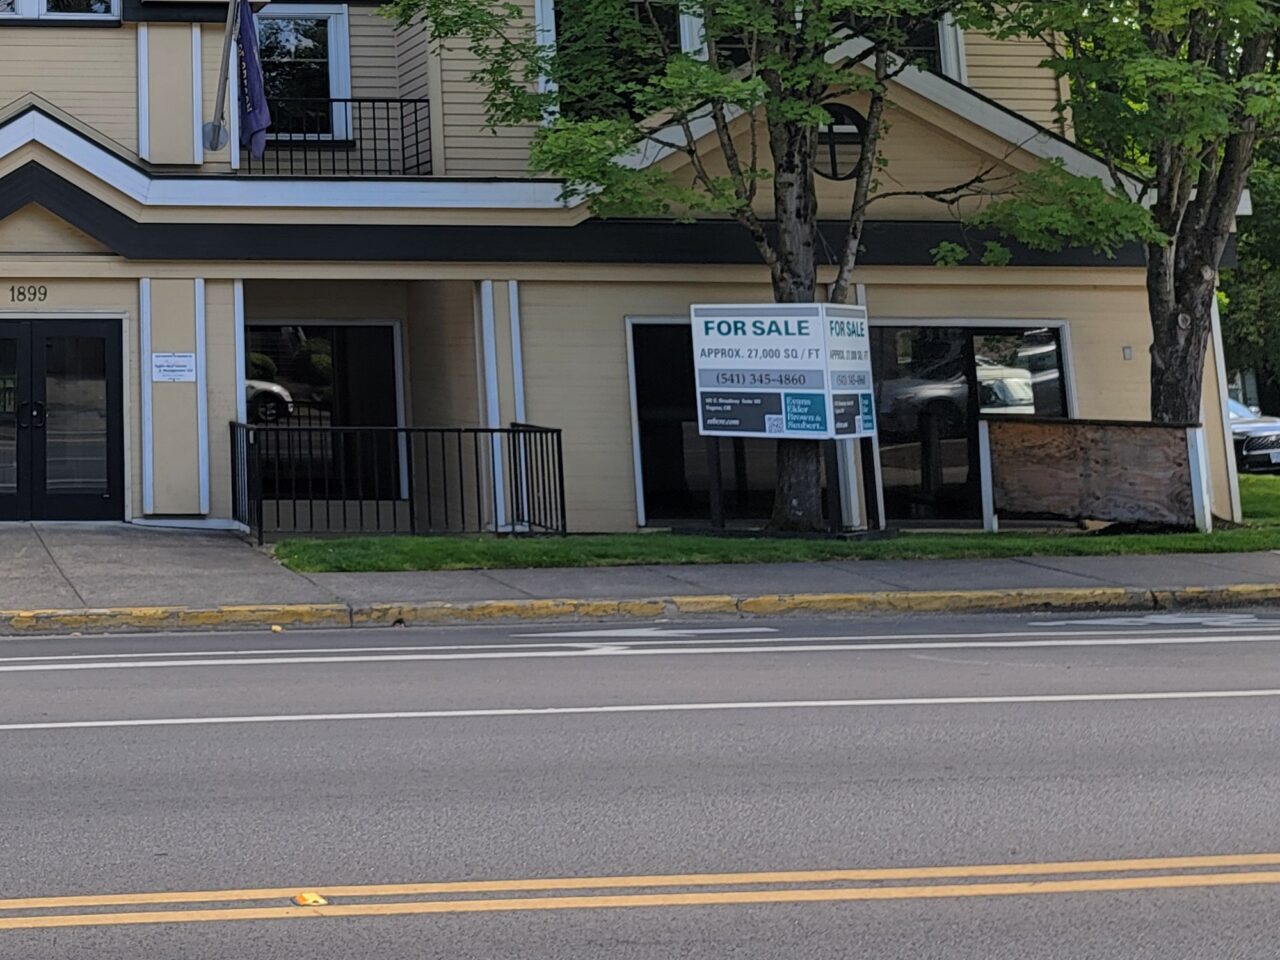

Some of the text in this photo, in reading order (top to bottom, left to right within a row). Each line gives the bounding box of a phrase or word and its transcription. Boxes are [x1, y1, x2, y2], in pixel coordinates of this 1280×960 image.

[9, 285, 48, 302] 1899
[704, 319, 810, 336] FOR SALE
[829, 320, 865, 338] FOR SALE
[700, 348, 744, 359] APPROX.
[747, 348, 780, 360] 27,000
[808, 348, 820, 359] FT
[716, 372, 806, 386] (541) 345-4860
